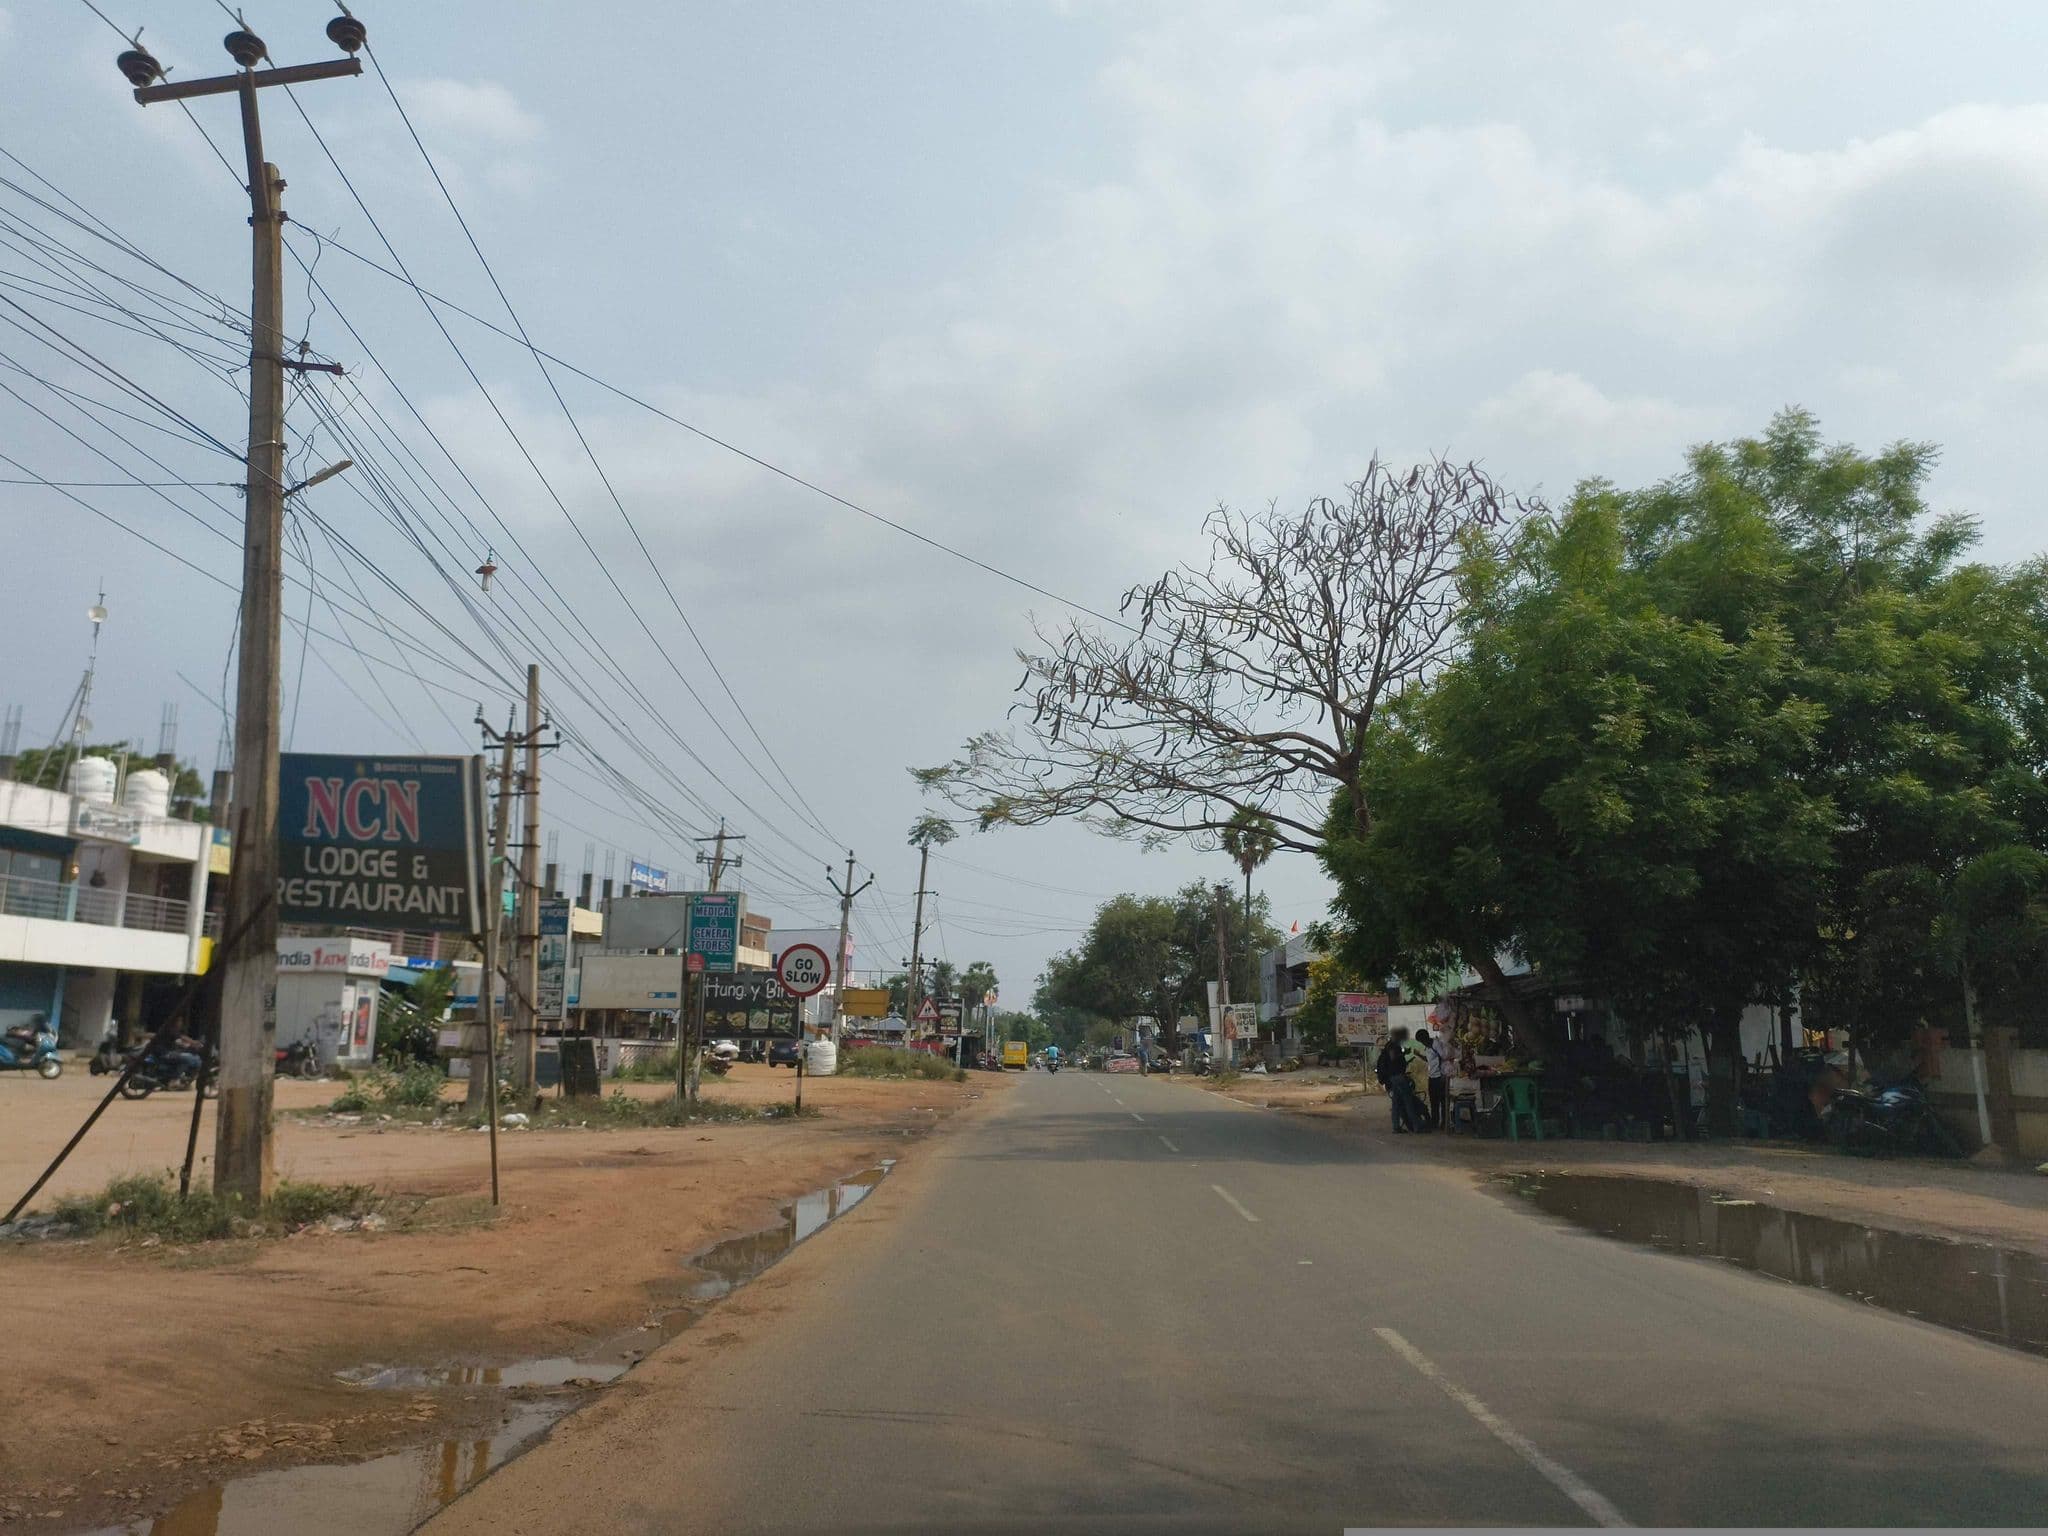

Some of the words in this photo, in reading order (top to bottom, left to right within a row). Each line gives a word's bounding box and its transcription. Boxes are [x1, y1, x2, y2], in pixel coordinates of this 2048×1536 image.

[303, 776, 421, 843] NCN
[304, 846, 398, 879] LODGE
[412, 855, 428, 880] &
[277, 877, 465, 915] RESTAURANT
[695, 905, 735, 917] MEDICAL
[709, 917, 719, 927] &
[693, 927, 733, 940] GENERAL
[795, 959, 813, 970] GO
[785, 970, 821, 984] SLOW
[704, 976, 760, 1002] Hungy
